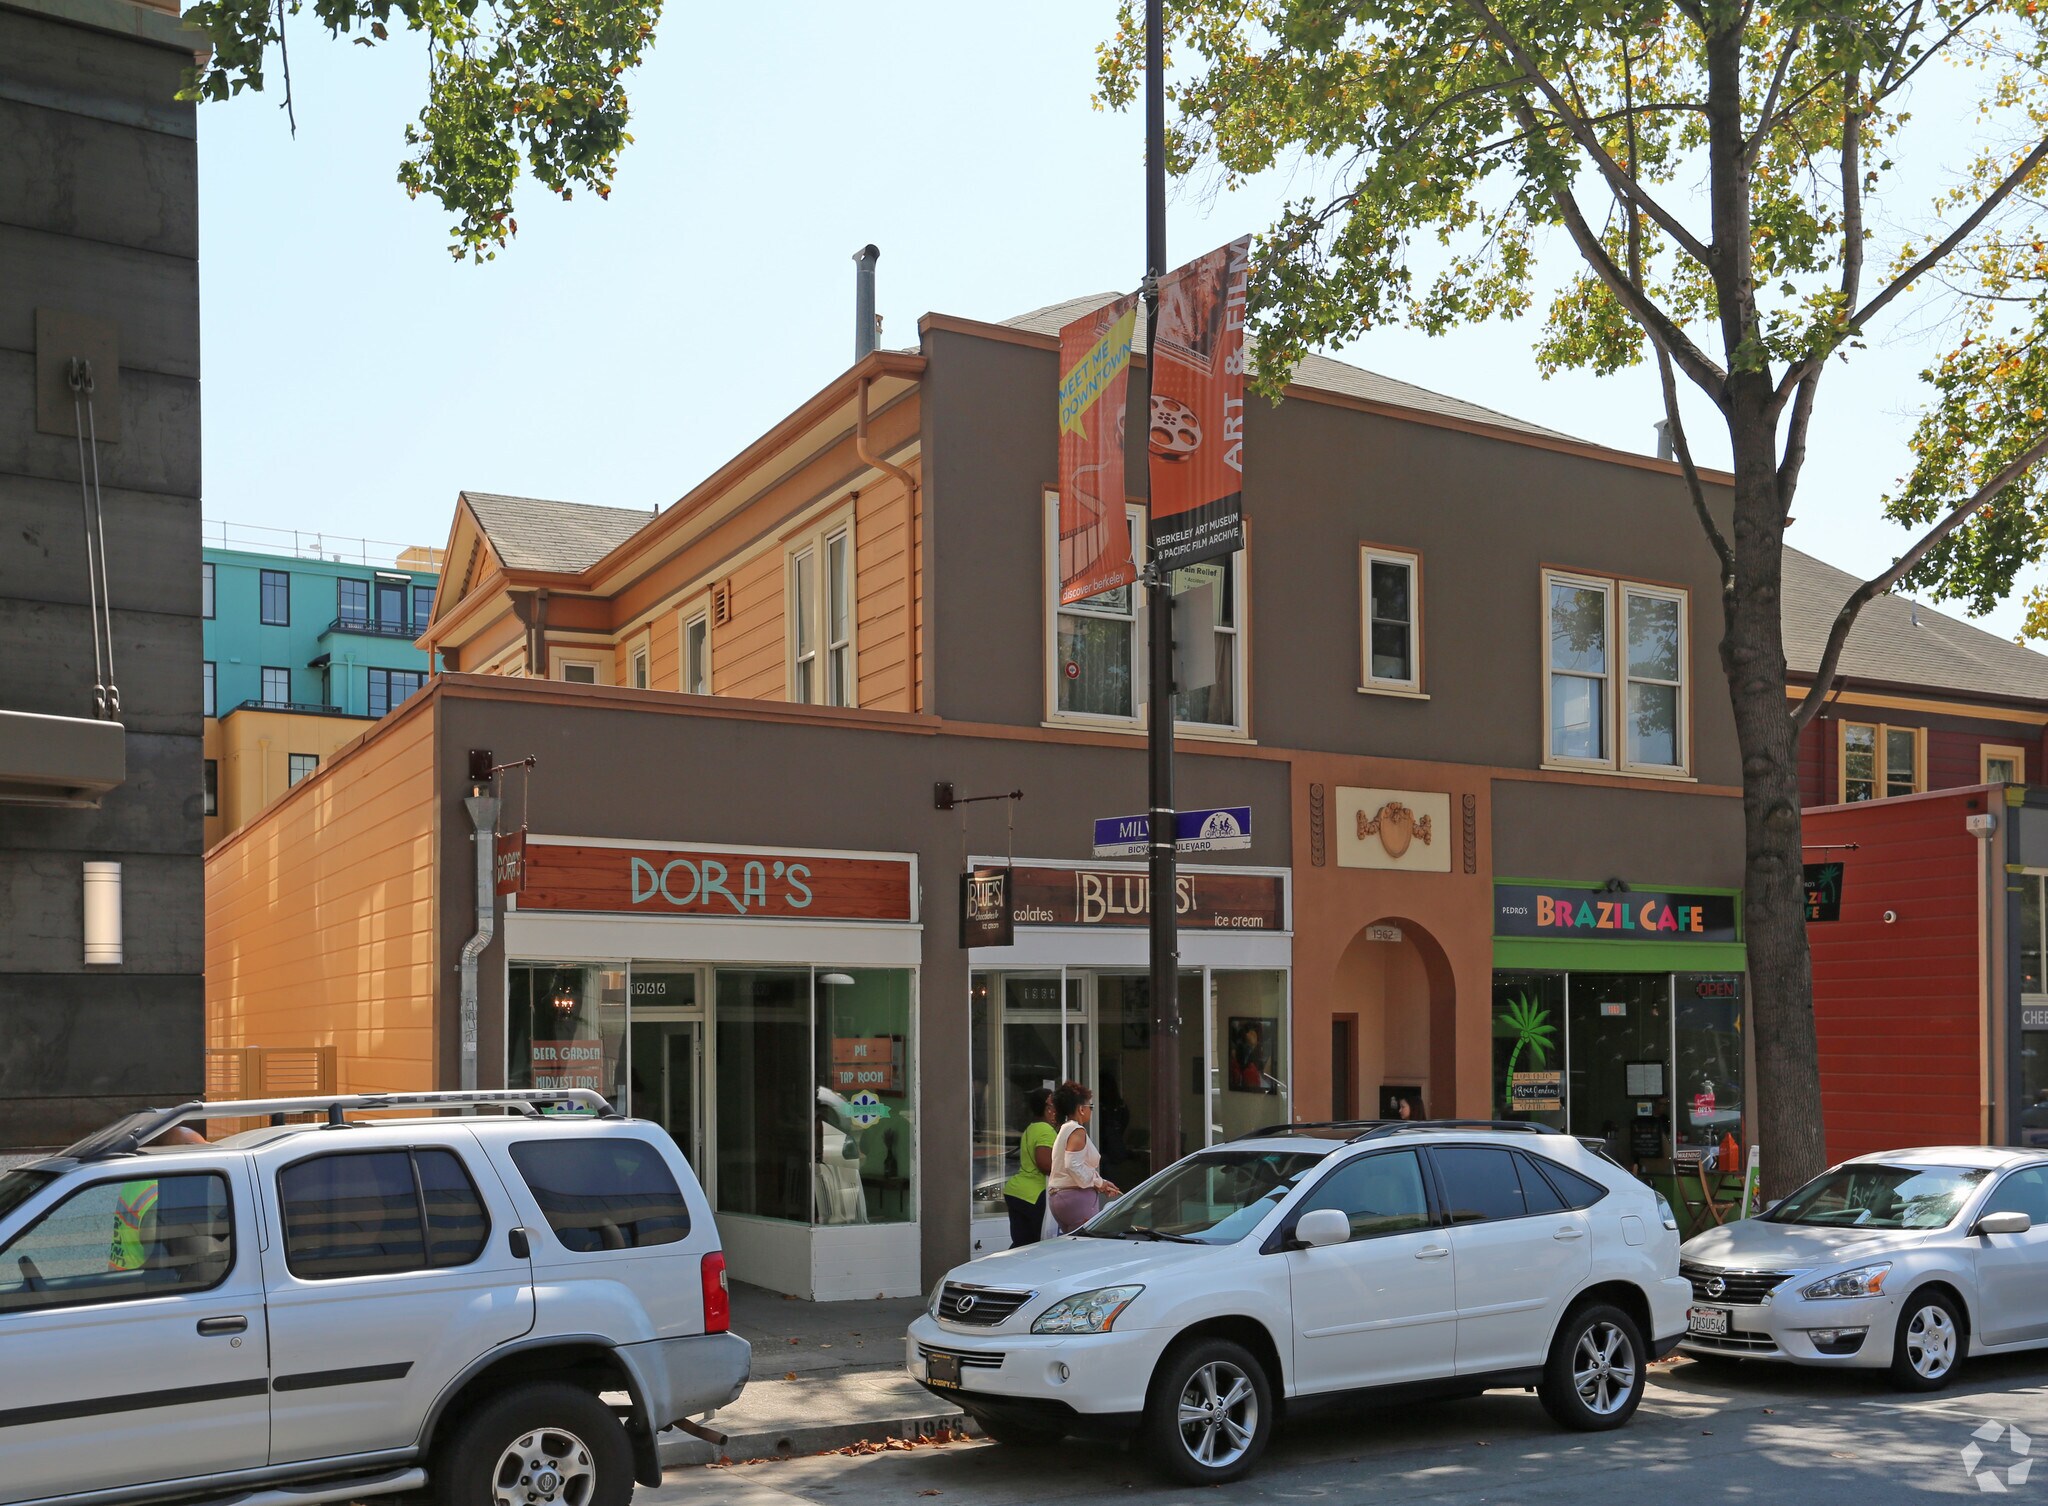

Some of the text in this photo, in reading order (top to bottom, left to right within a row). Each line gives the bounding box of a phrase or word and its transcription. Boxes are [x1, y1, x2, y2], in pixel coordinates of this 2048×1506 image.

[1224, 236, 1248, 472] ART & FILM
[1059, 340, 1109, 405] MEET ME
[1062, 338, 1132, 424] DOWNTOWN
[1156, 512, 1238, 546] BERKELEY ART MUSEUM
[1158, 527, 1239, 560] & PACIFIC FILM ARCHIVE
[1197, 567, 1217, 577] Relief
[1063, 572, 1124, 601] discover berkeley
[1119, 820, 1150, 838] MIL
[631, 857, 812, 914] DORA'S
[969, 880, 1001, 918] BLUE'S
[1082, 874, 1190, 923] BLUS
[1805, 891, 1828, 905] ZIL
[1502, 906, 1528, 915] PEDRO'S
[1537, 895, 1704, 933] BRAZIL CAFE
[1214, 912, 1264, 928] ice cream
[1373, 929, 1393, 940] 1962
[631, 982, 665, 995] 1966
[1699, 983, 1734, 996] OPEN
[533, 1047, 601, 1061] BEER GARDEN
[854, 1045, 867, 1056] PIE
[575, 1075, 599, 1088] FARE
[840, 1071, 883, 1084] TAP ROOM
[1697, 1106, 1712, 1114] OPEN
[1691, 1316, 1726, 1332] 7HSU546
